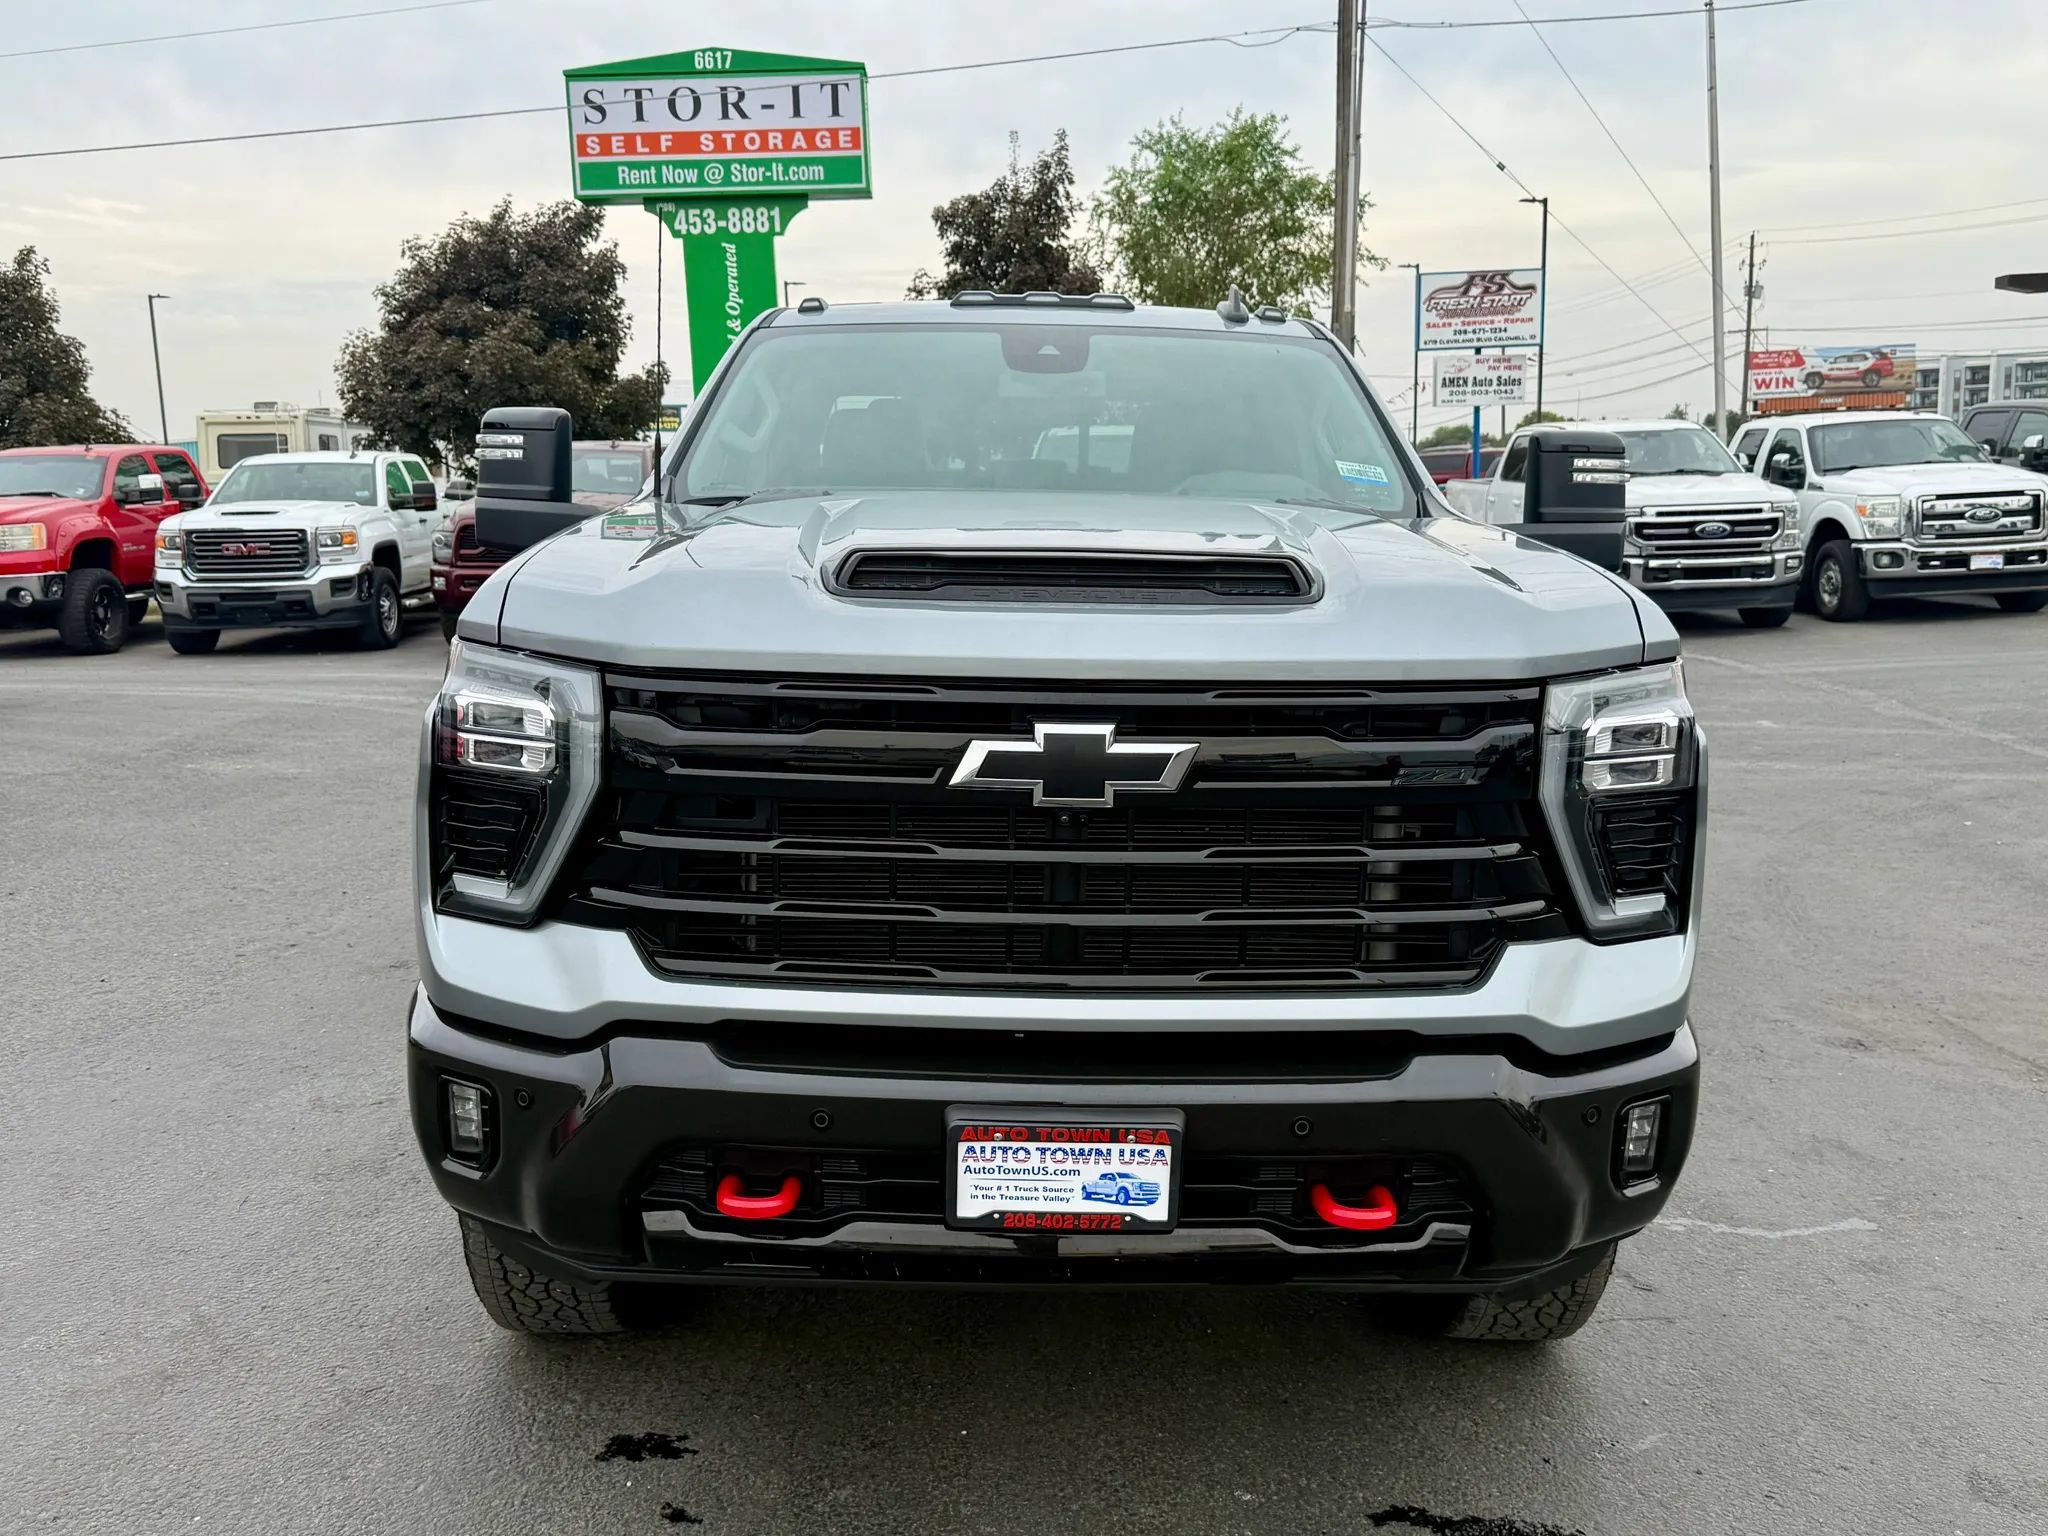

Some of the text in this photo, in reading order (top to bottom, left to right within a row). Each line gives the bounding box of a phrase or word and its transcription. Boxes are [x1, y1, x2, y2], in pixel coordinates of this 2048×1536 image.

[694, 51, 732, 70] 6617
[582, 82, 851, 125] STOR-IT
[585, 129, 853, 155] SELF STORAGE
[617, 161, 824, 185] Rent Now @ Stor-It.com
[673, 206, 782, 235] 453-8881
[721, 242, 744, 317] Operated
[1426, 292, 1532, 312] FRESH START
[1425, 321, 1452, 329] SALES
[1460, 319, 1495, 327] SERVICE
[1441, 375, 1522, 389] AMEN Auto Sales
[1754, 377, 1794, 390] WIN
[221, 543, 271, 556] GMC
[960, 1127, 1171, 1144] AUTO TOWN USA
[961, 1146, 1169, 1166] AUTO TOWN USA
[963, 1165, 1081, 1177] AutoTownUS.com
[1003, 1213, 1122, 1229] 208-402-5772
